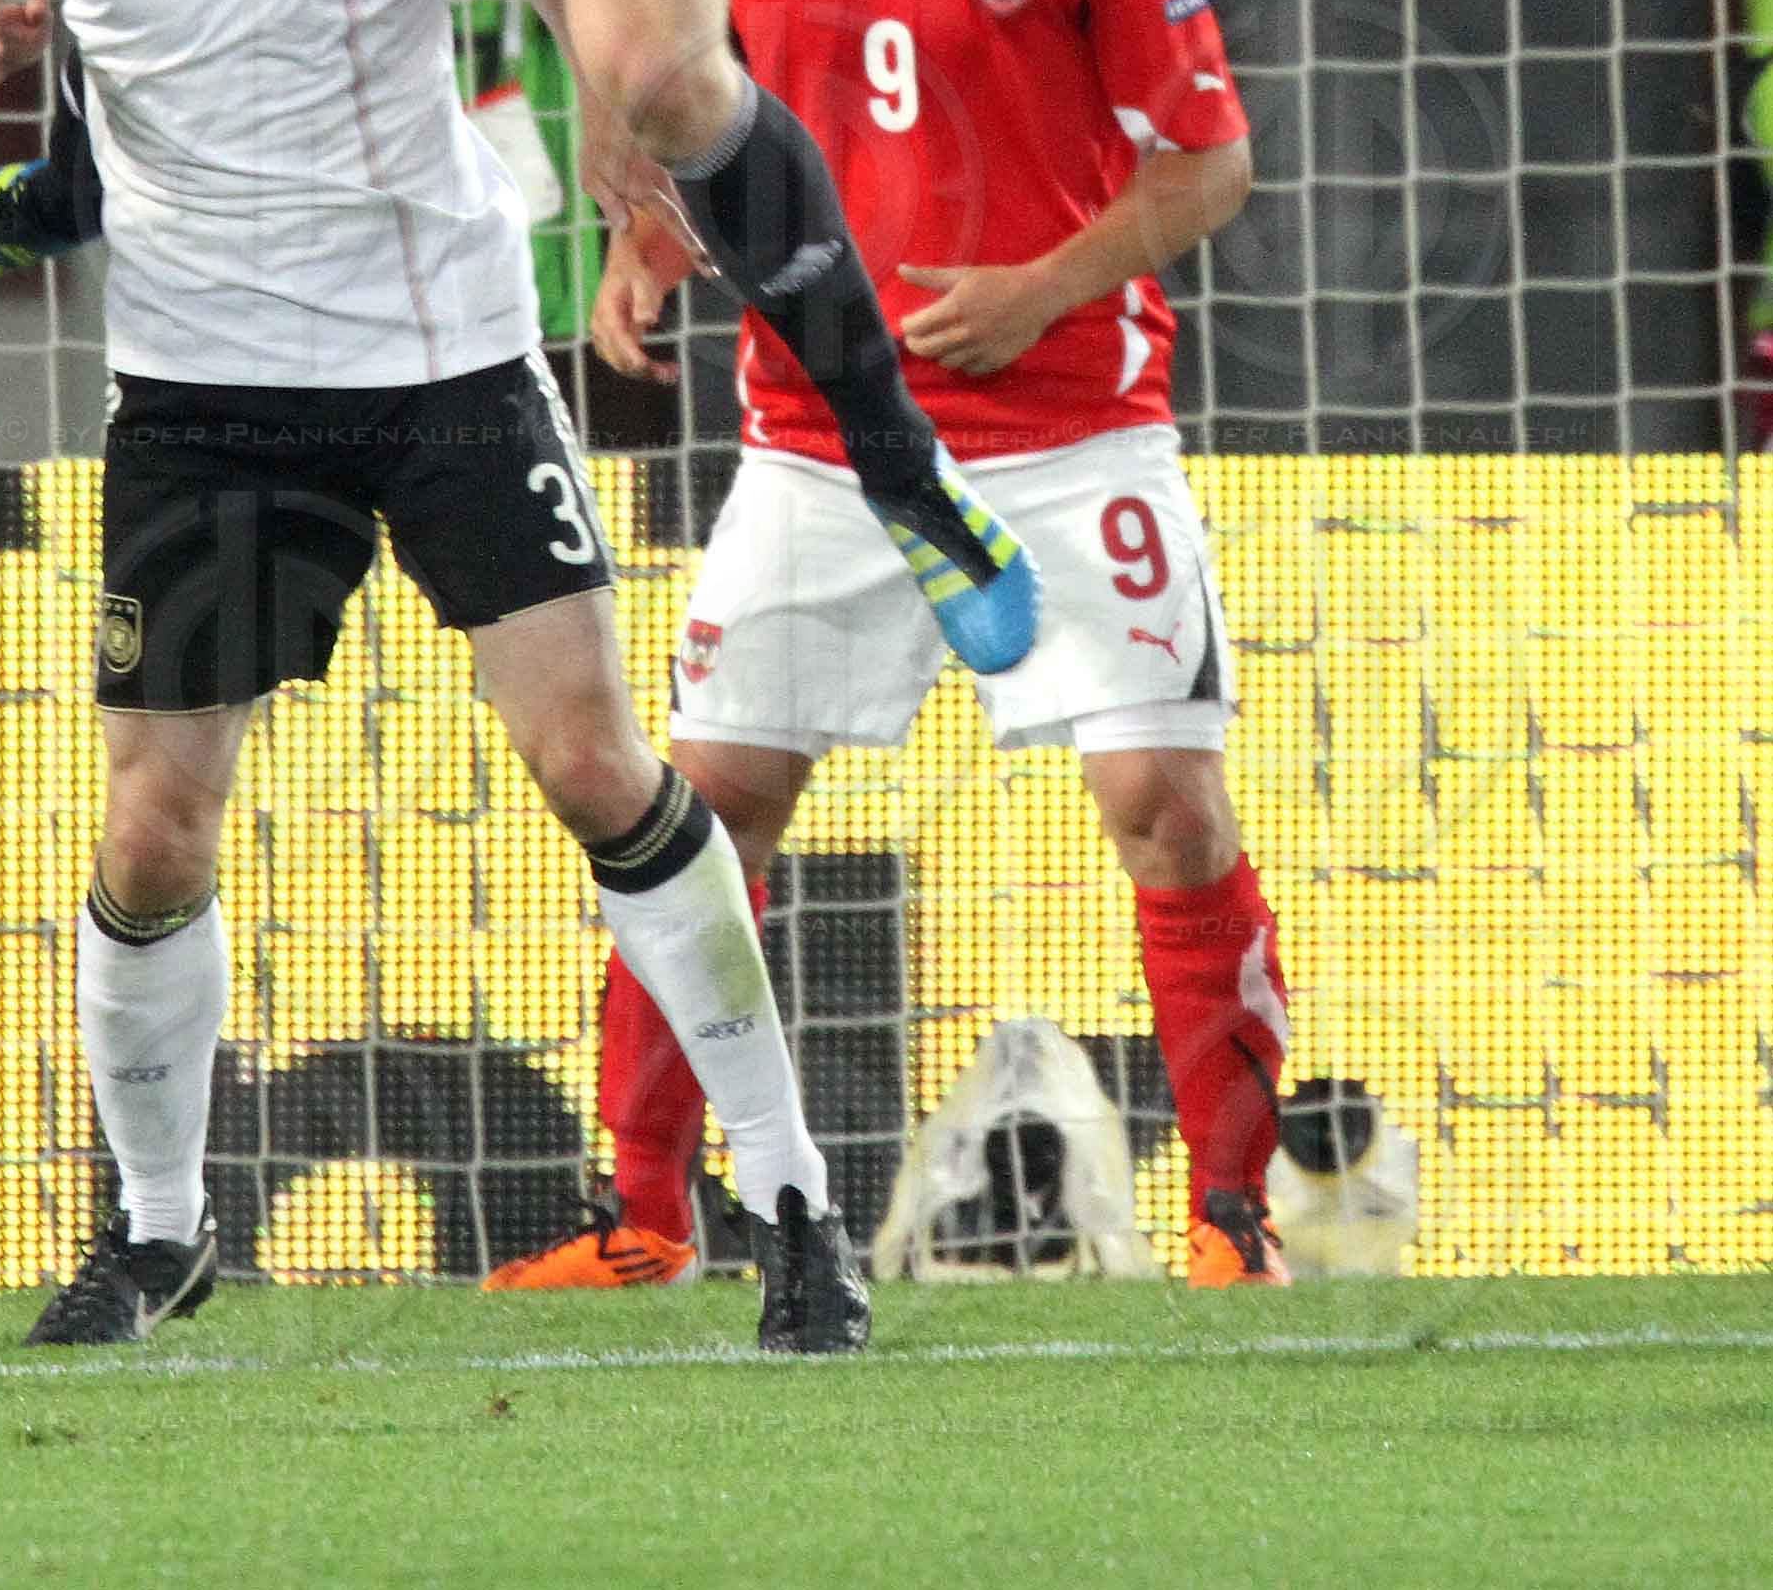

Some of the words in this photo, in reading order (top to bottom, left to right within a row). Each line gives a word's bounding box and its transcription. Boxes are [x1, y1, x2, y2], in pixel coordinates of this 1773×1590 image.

[863, 19, 920, 132] 9
[527, 462, 595, 565] 3
[1099, 495, 1171, 600] 9
